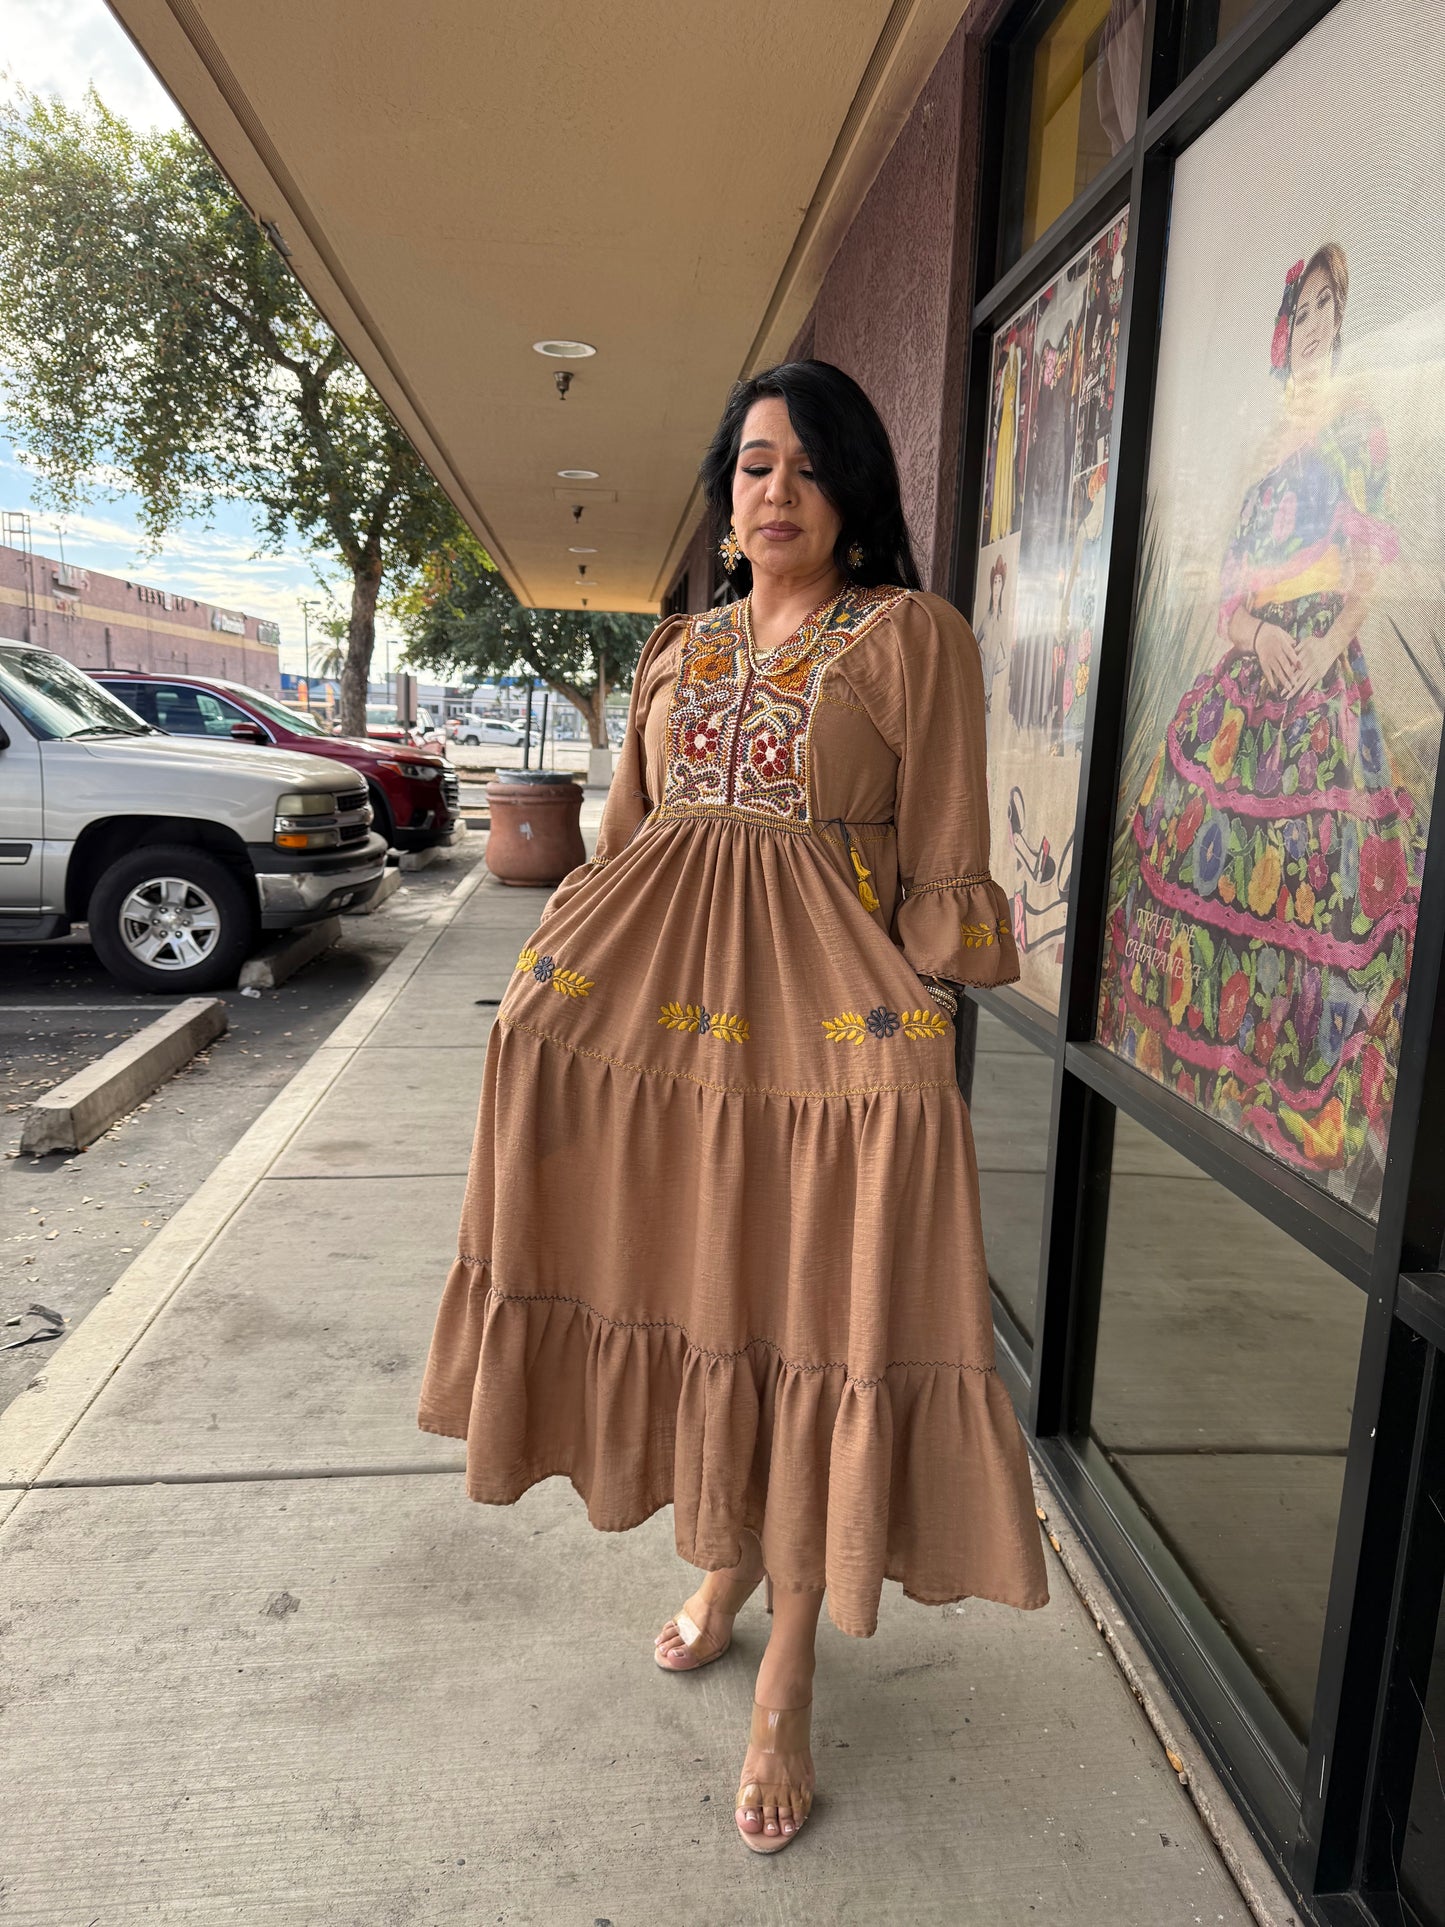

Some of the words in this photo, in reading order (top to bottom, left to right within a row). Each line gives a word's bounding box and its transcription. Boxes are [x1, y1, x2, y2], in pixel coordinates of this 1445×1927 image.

[138, 587, 164, 606] BEST
[1137, 908, 1178, 941] TRAJES
[1180, 922, 1197, 948] DE
[1125, 938, 1202, 987] CHIAPANECA
